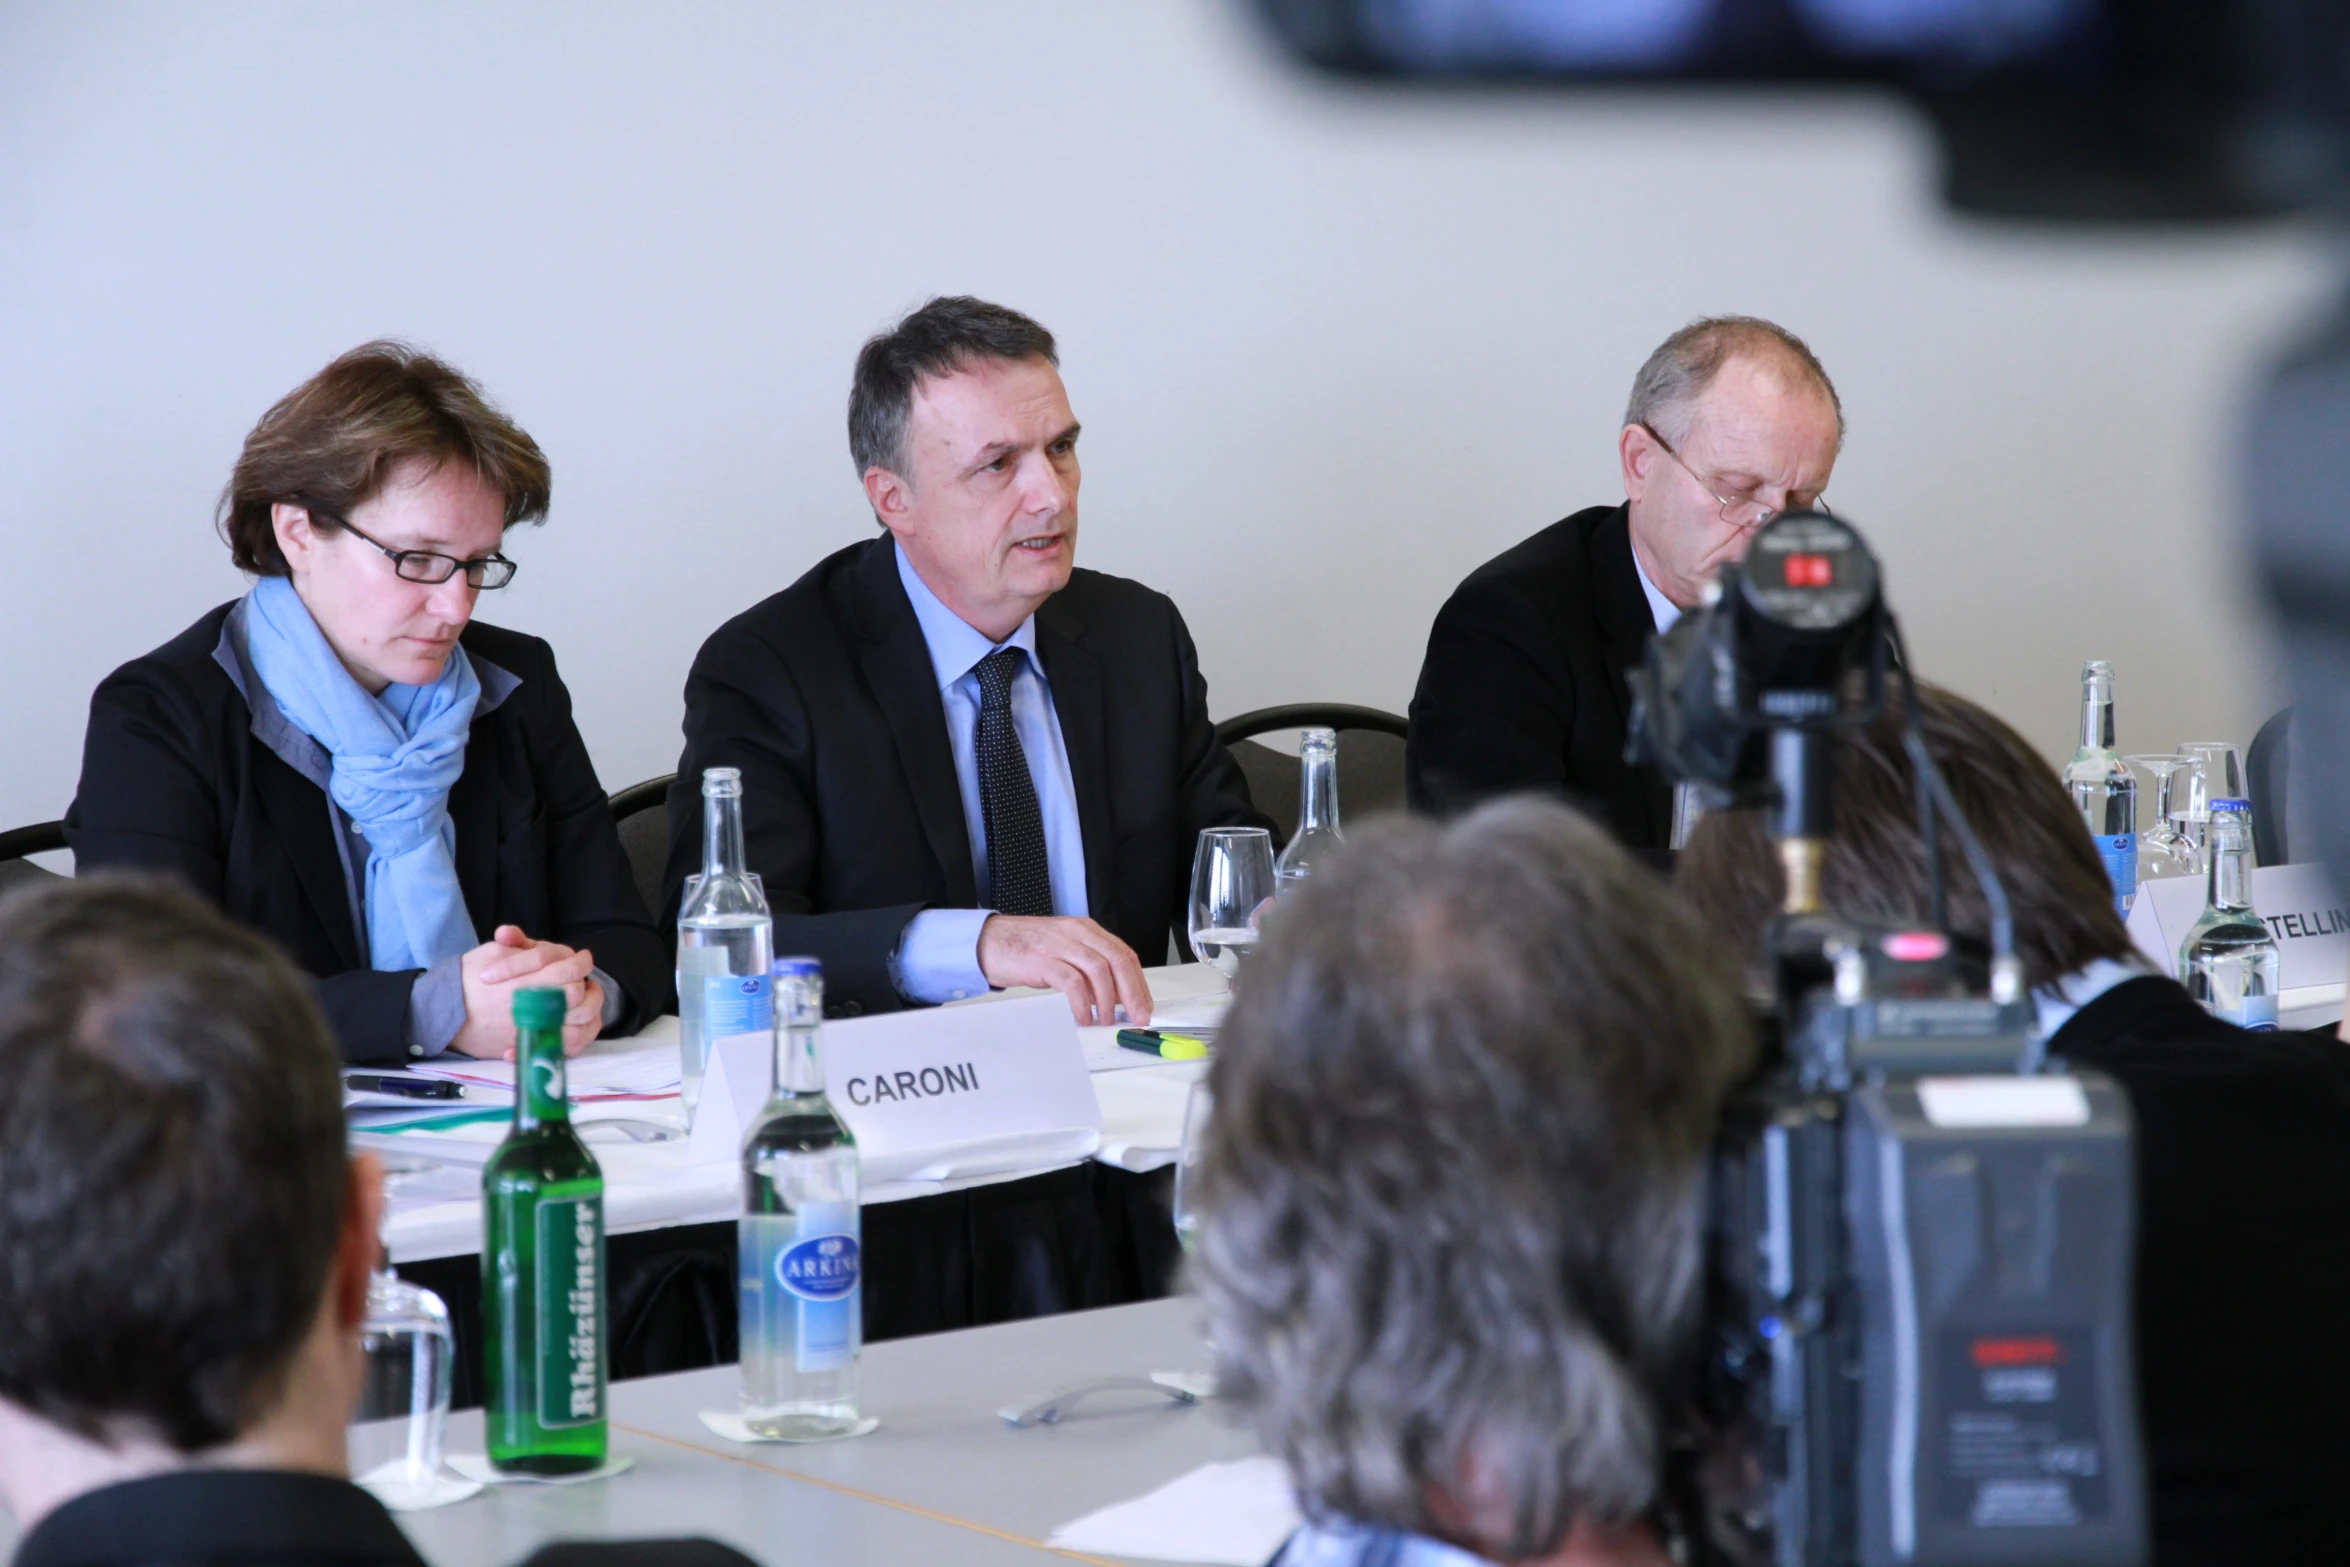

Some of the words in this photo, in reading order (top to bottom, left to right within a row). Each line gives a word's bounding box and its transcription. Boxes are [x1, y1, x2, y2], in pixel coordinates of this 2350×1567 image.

[2259, 909, 2350, 940] TELLIN
[846, 1062, 980, 1107] CARONI
[568, 1201, 598, 1419] Rhäzünser
